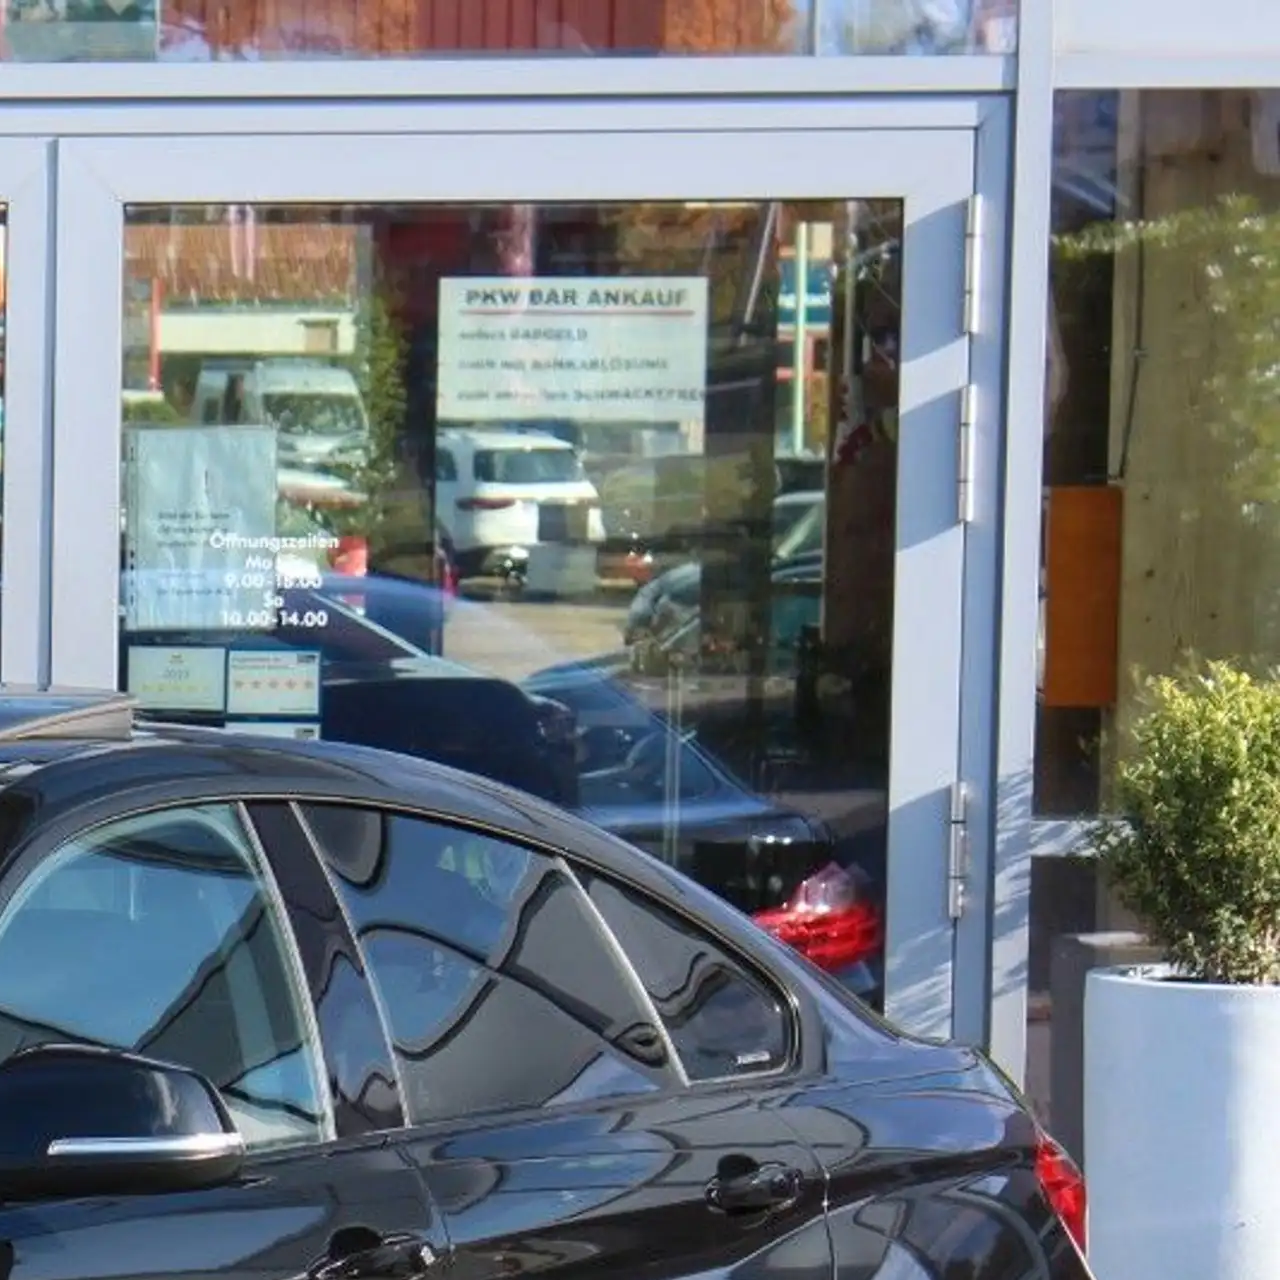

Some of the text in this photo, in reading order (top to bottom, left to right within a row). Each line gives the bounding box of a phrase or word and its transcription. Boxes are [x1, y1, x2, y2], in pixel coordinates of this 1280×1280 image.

[465, 288, 688, 306] PKW BAR ANKAUF
[209, 529, 339, 550] Öffnungszeiten
[244, 555, 273, 570] Mo
[262, 590, 284, 608] Sa
[222, 610, 329, 627] 10.00-14.00
